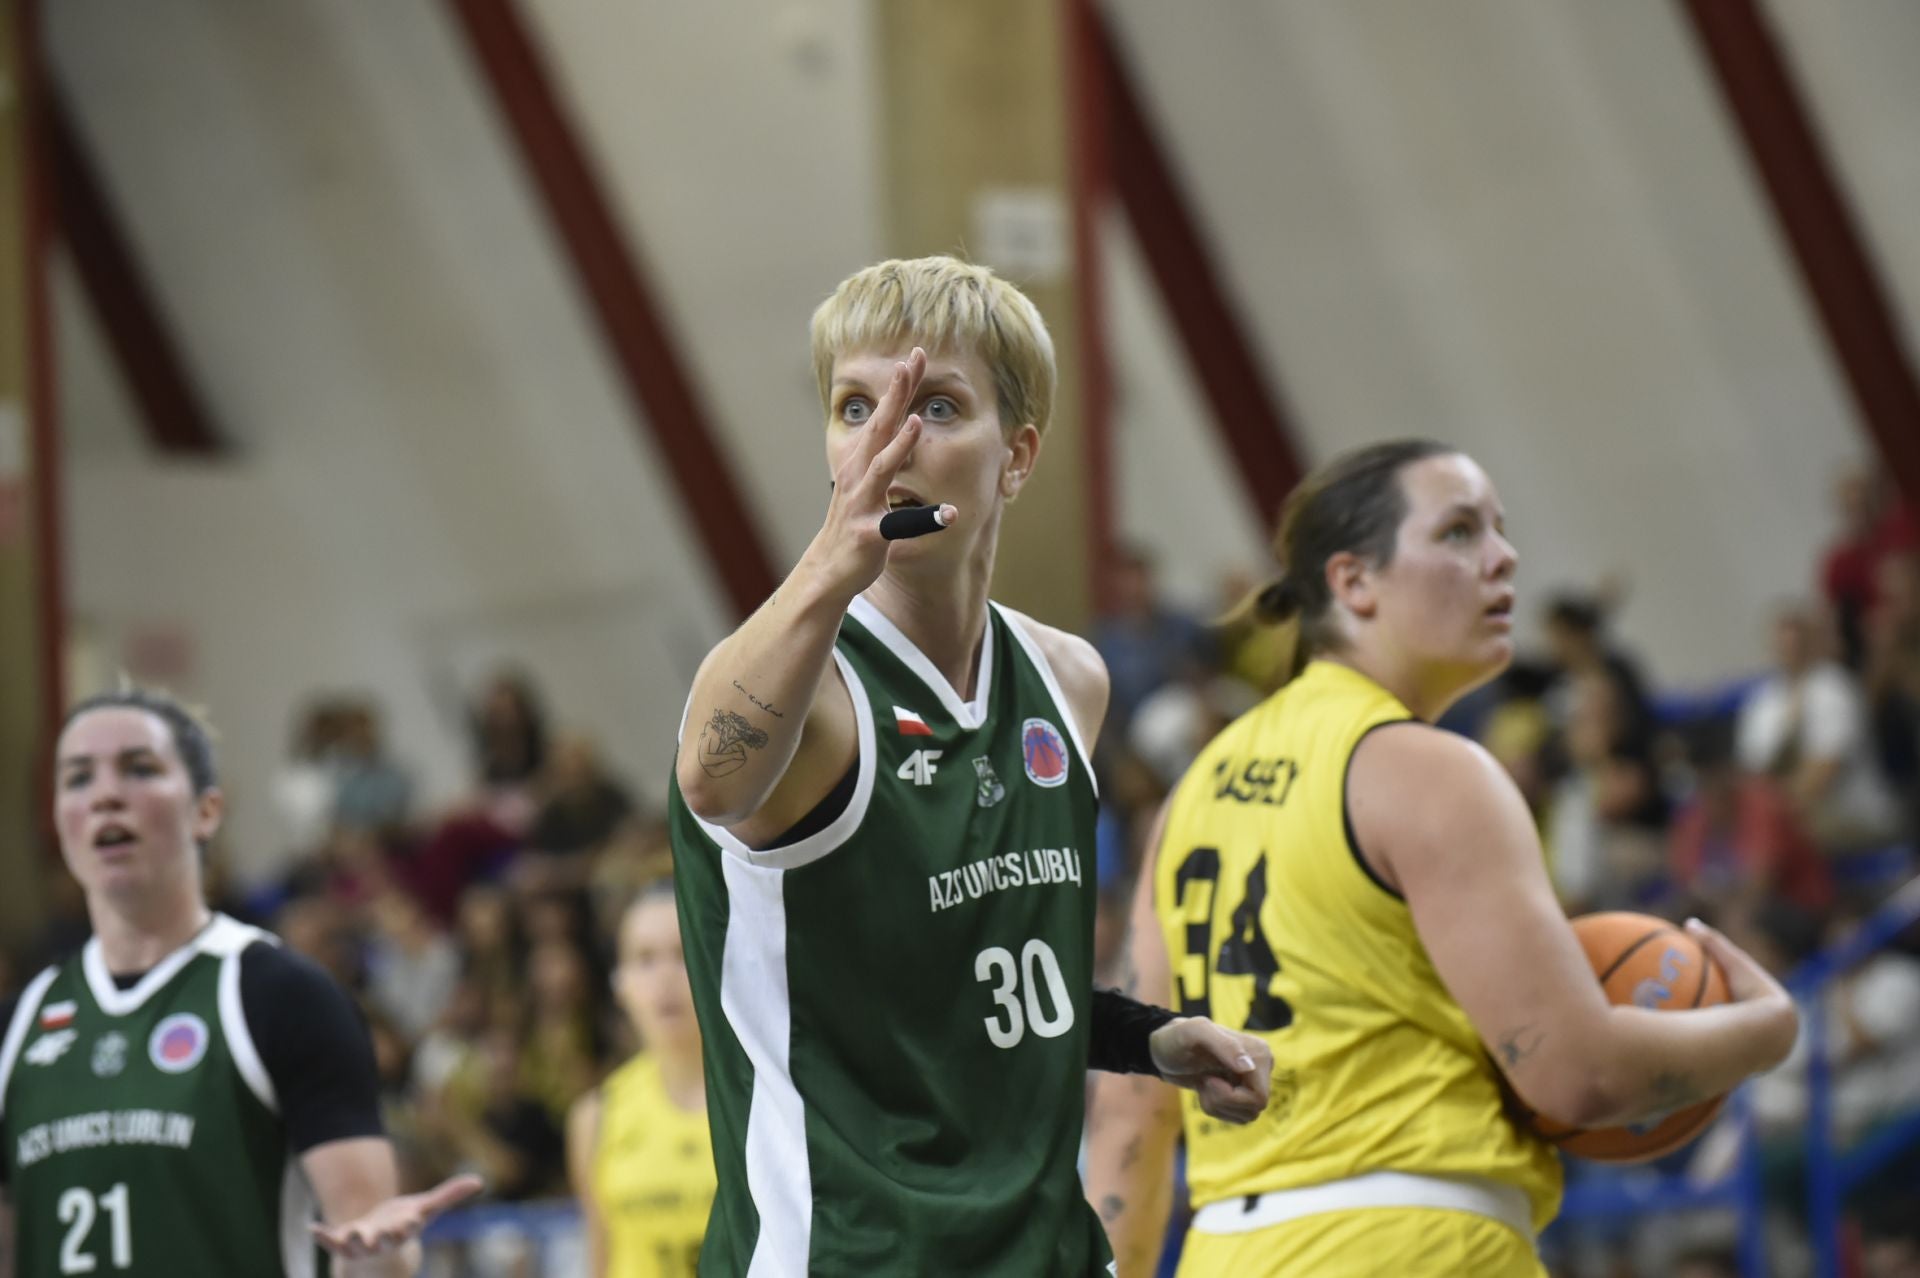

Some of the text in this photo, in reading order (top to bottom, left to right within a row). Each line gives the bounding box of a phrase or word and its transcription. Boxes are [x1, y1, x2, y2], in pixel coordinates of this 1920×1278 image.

[897, 749, 943, 786] 4F
[928, 868, 964, 913] AZS
[962, 852, 1024, 900] UMCS
[1174, 846, 1295, 1031] 34
[974, 938, 1075, 1049] 30
[57, 1182, 132, 1276] 21
